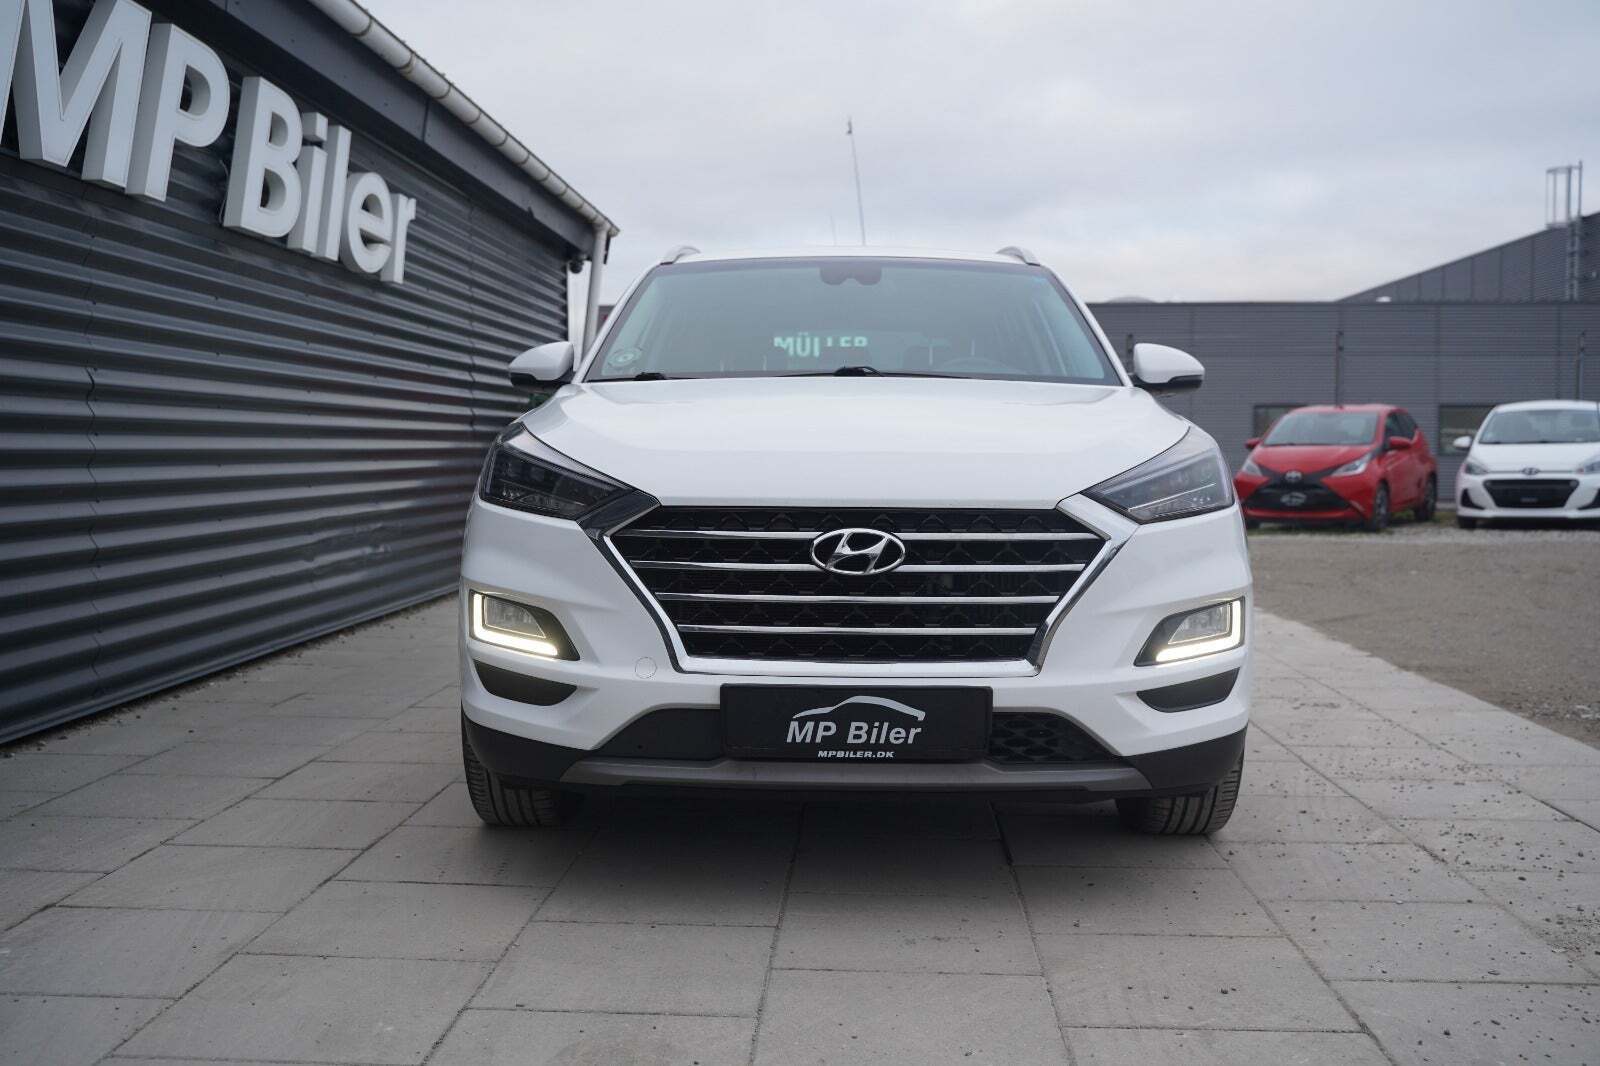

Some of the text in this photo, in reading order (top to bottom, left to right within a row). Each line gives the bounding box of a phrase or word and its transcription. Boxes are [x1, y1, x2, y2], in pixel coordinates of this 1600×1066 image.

[0, 0, 416, 284] MP Biler
[787, 720, 922, 744] MP Biler
[817, 750, 895, 760] MPBILER.DK
